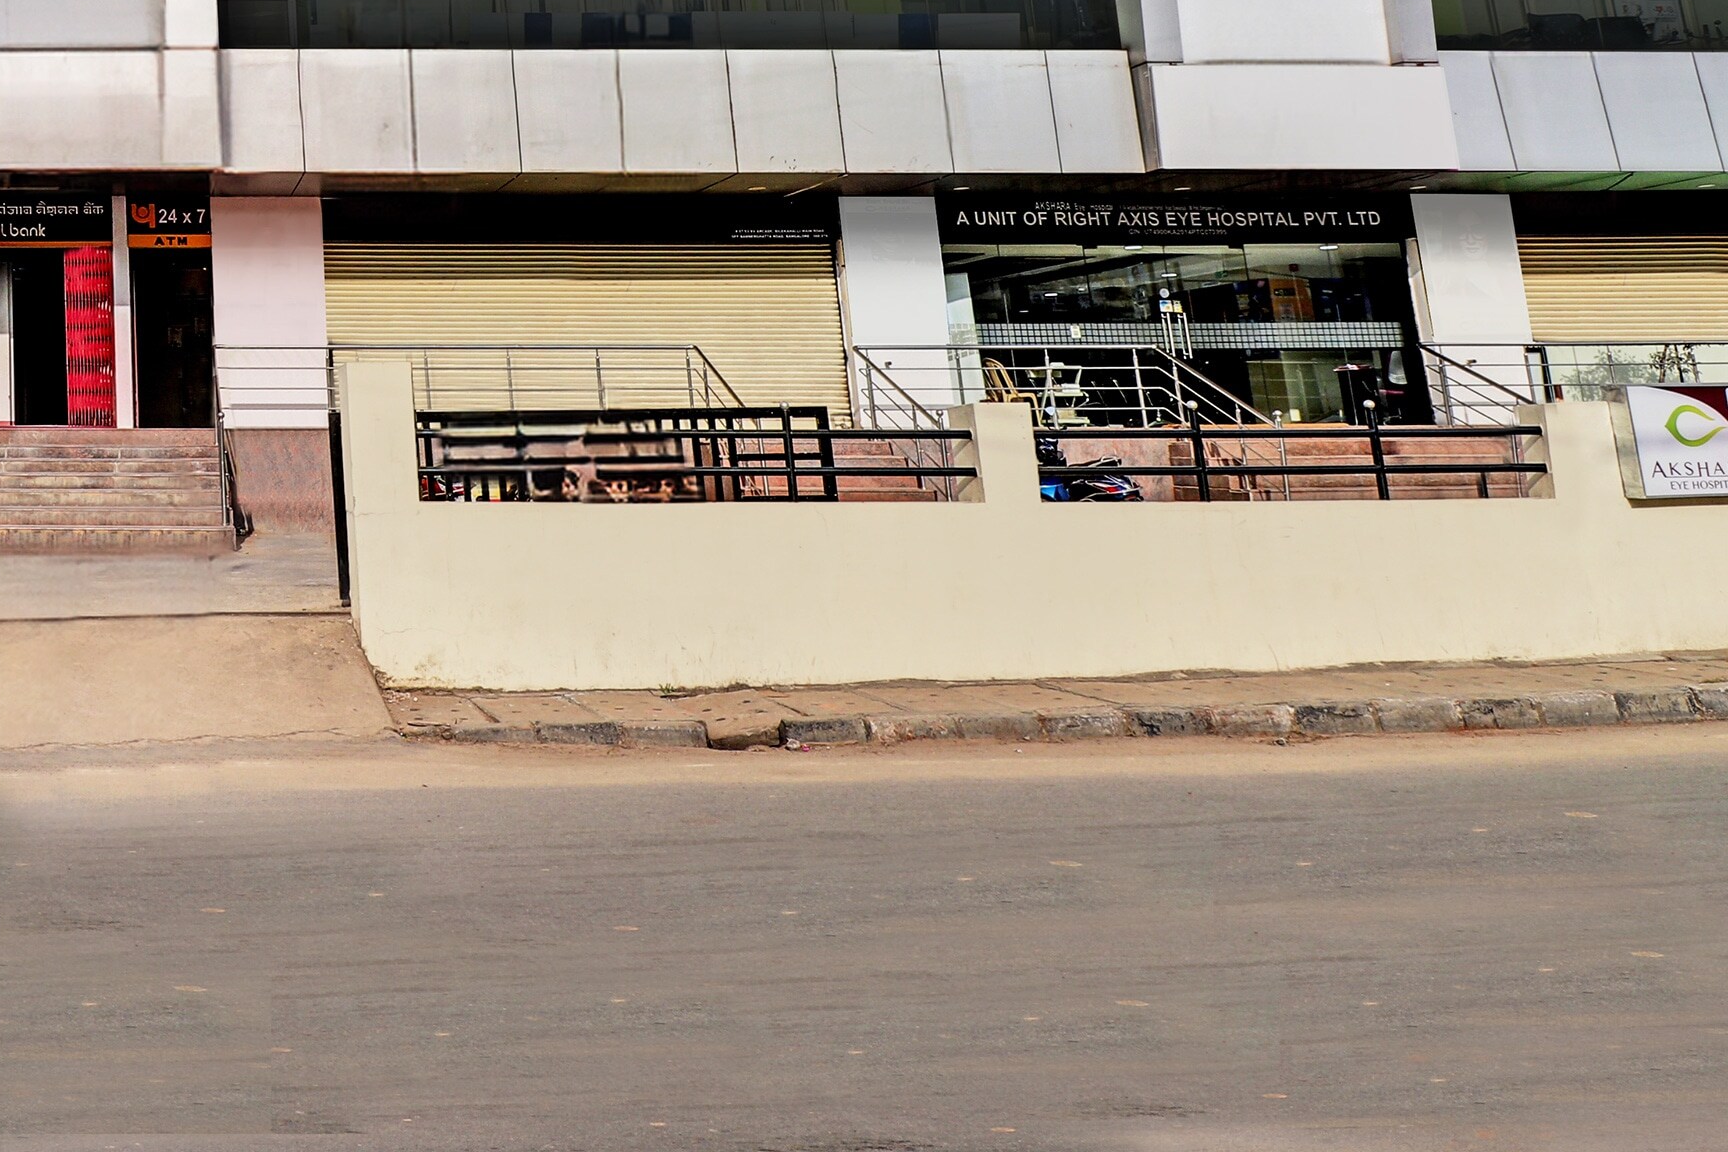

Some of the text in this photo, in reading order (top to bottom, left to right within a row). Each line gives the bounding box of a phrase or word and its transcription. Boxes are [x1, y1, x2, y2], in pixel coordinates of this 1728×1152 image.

[83, 201, 104, 215] बैंक
[1035, 202, 1071, 211] AKSHARA
[158, 209, 206, 224] 24 x 7
[957, 211, 1380, 226] A UNIT OF RIGHT AXIS EYE HOSPITAL PVT. LTD
[9, 223, 46, 237] bank
[154, 236, 188, 246] ATM
[1671, 480, 1689, 490] EYE
